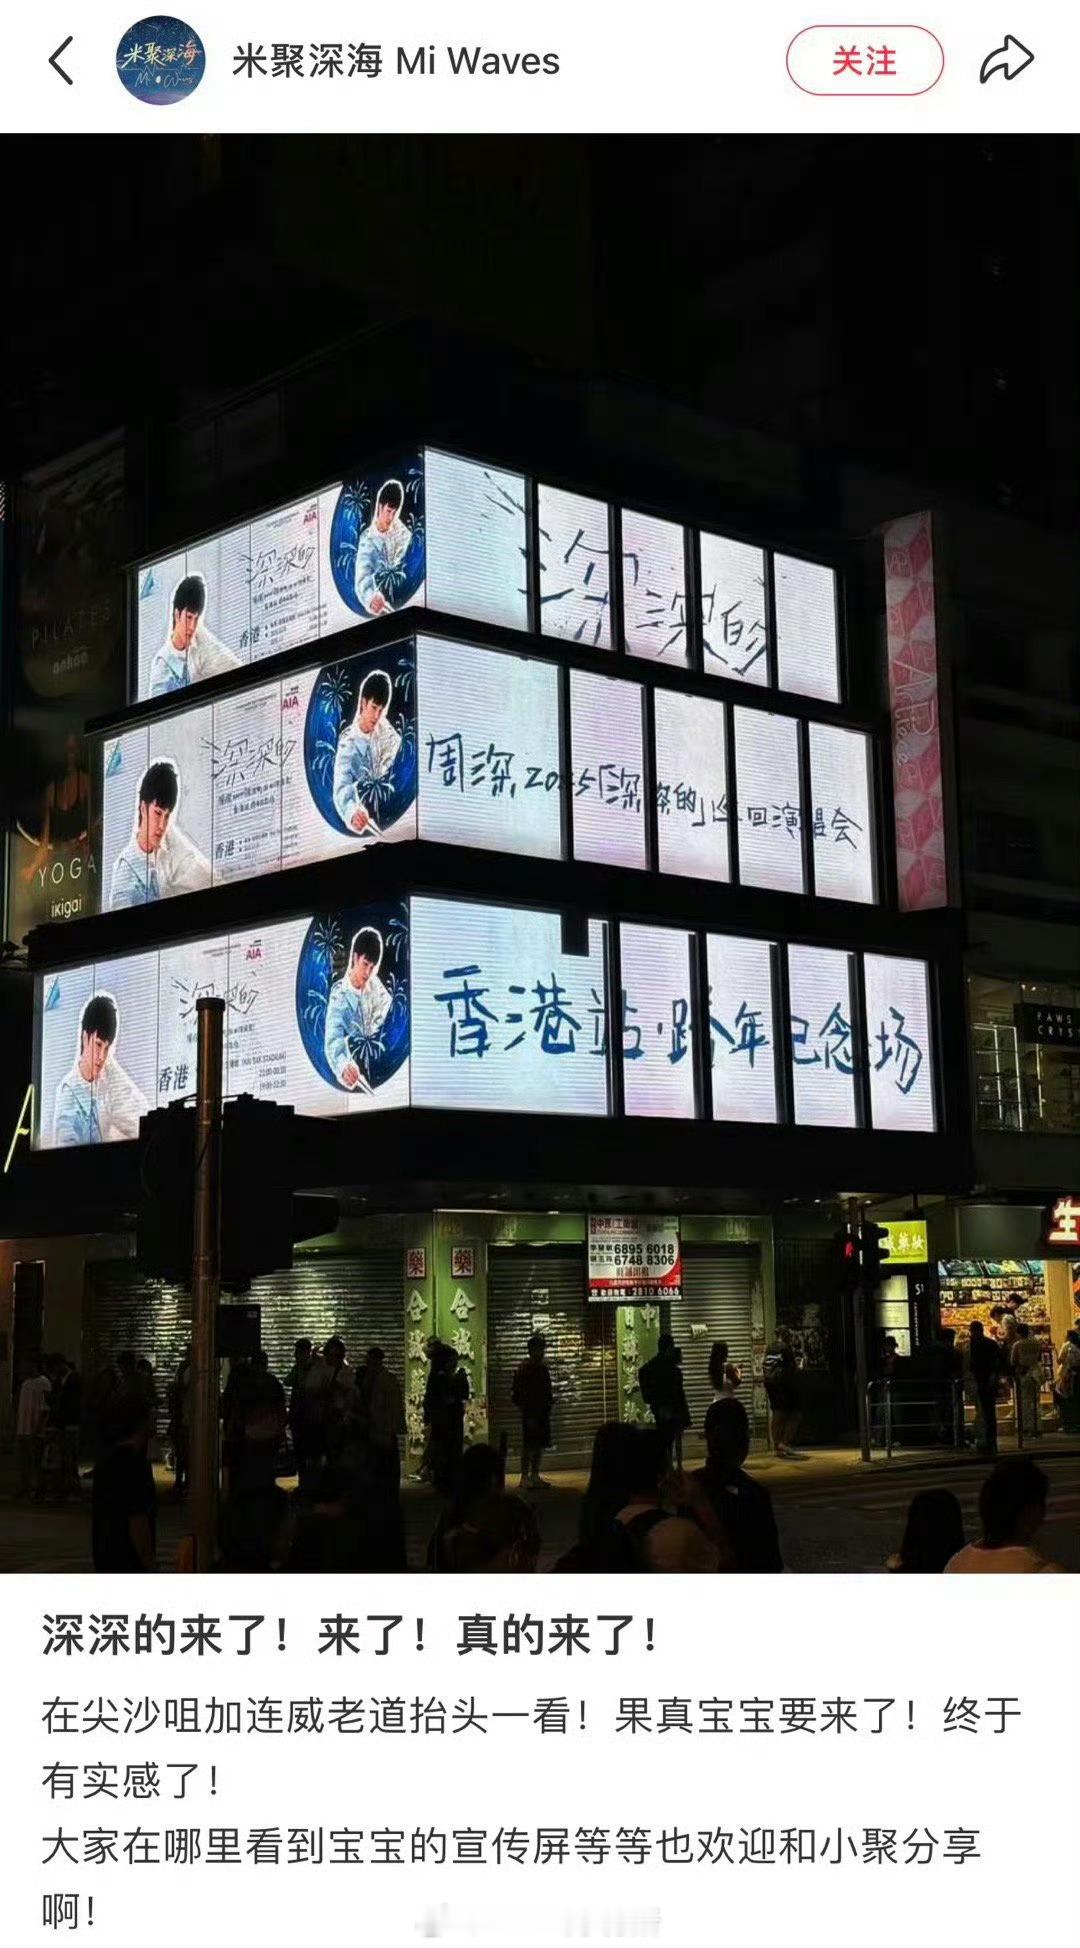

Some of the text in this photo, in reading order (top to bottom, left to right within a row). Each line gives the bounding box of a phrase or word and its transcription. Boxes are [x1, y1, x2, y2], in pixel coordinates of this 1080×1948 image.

[282, 696, 299, 711] AIA
[38, 853, 97, 888] YOGA
[51, 894, 82, 919] ikigai
[614, 1244, 642, 1254] 6895
[646, 1244, 674, 1254] 6018
[614, 1255, 642, 1265] 6748
[646, 1255, 674, 1265] 8306
